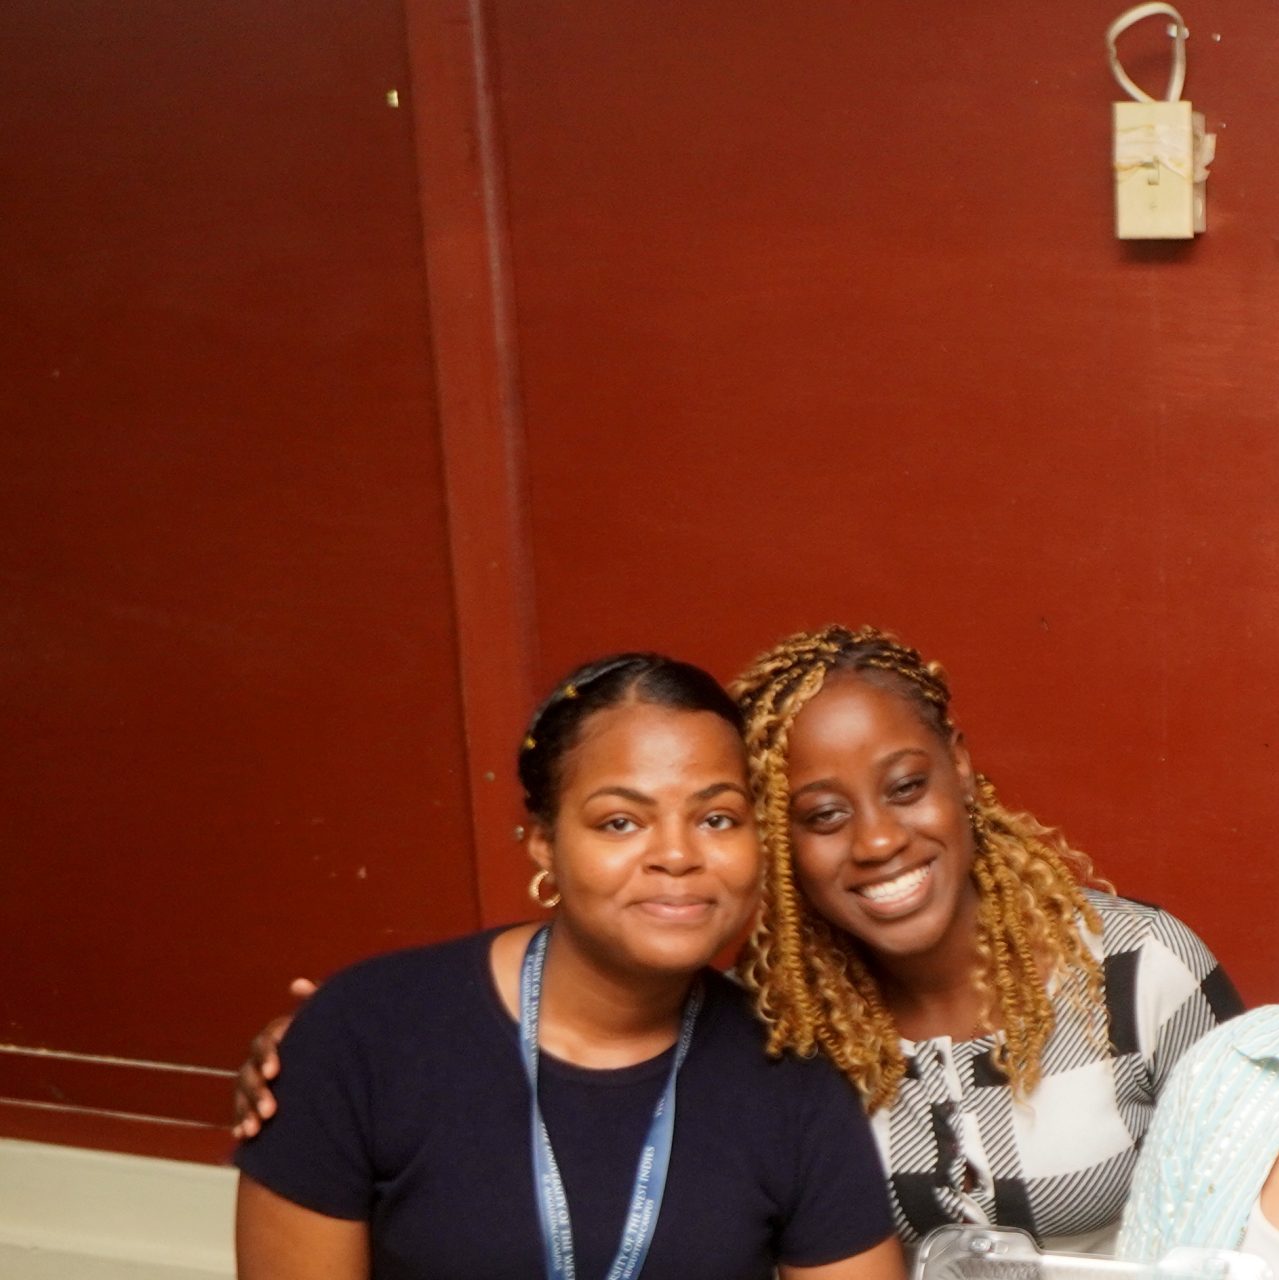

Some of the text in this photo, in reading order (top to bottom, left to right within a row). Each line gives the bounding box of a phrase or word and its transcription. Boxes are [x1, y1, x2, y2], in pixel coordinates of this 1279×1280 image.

[636, 1143, 657, 1182] INDIES
[630, 1182, 648, 1211] WEST
[557, 1209, 568, 1224] OF
[627, 1211, 643, 1236] THE
[560, 1228, 572, 1251] THE
[621, 1231, 647, 1279] AUGUSTINE
[639, 1197, 656, 1233] CAMPUS
[622, 1236, 636, 1253] OF
